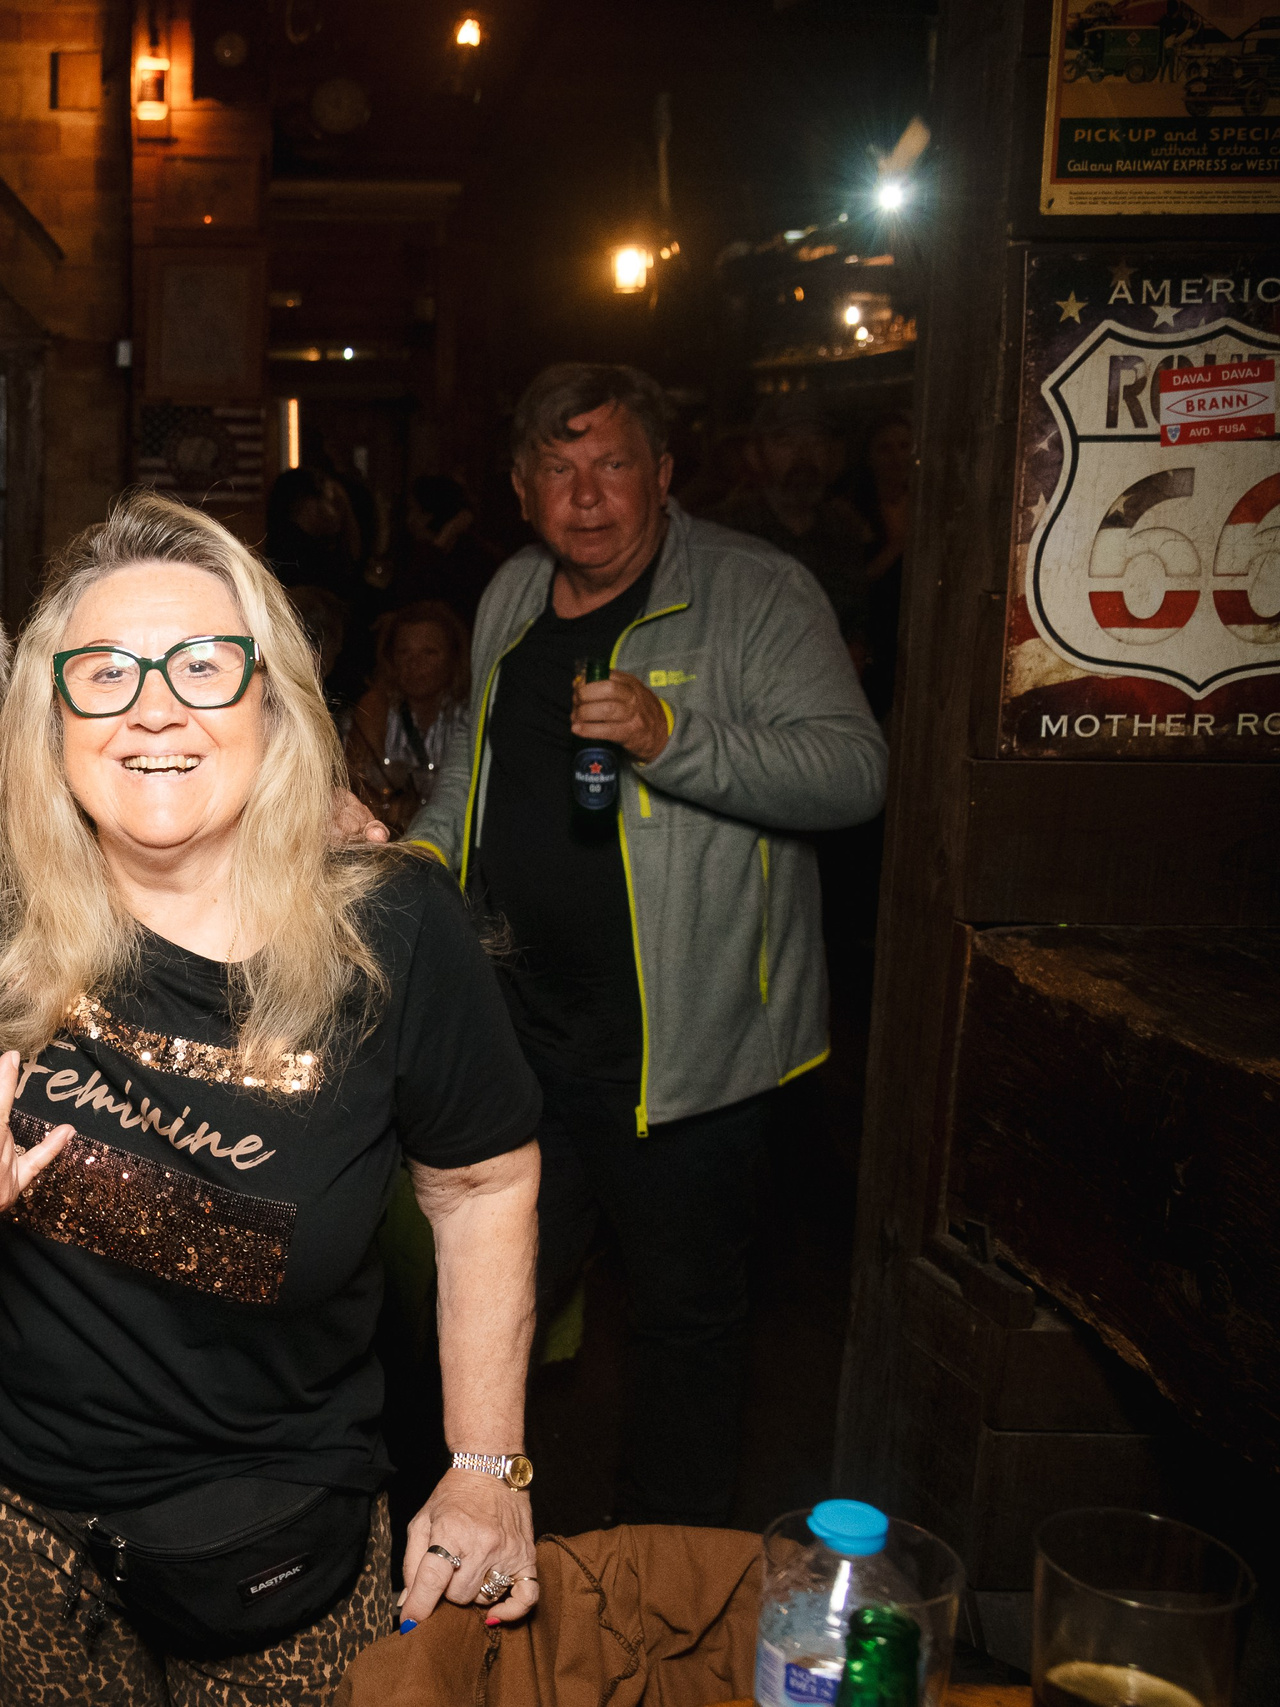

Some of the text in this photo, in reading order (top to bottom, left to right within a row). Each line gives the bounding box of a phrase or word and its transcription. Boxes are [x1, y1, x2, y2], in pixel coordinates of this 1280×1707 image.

[1163, 128, 1198, 142] and
[1150, 142, 1209, 157] without
[1217, 143, 1261, 157] extra
[1067, 159, 1088, 172] Call
[1089, 162, 1113, 173] any
[1116, 159, 1170, 172] RAILWAY
[1172, 159, 1228, 172] EXPRESS
[1229, 161, 1244, 172] or
[1172, 367, 1261, 386] DAVAJ DAVAJ
[1185, 394, 1248, 413] BRANN
[1188, 427, 1213, 438] AVD.
[1218, 423, 1247, 435] FUSA
[1039, 713, 1216, 738] MOTHER
[249, 1565, 302, 1594] EASTPAK
